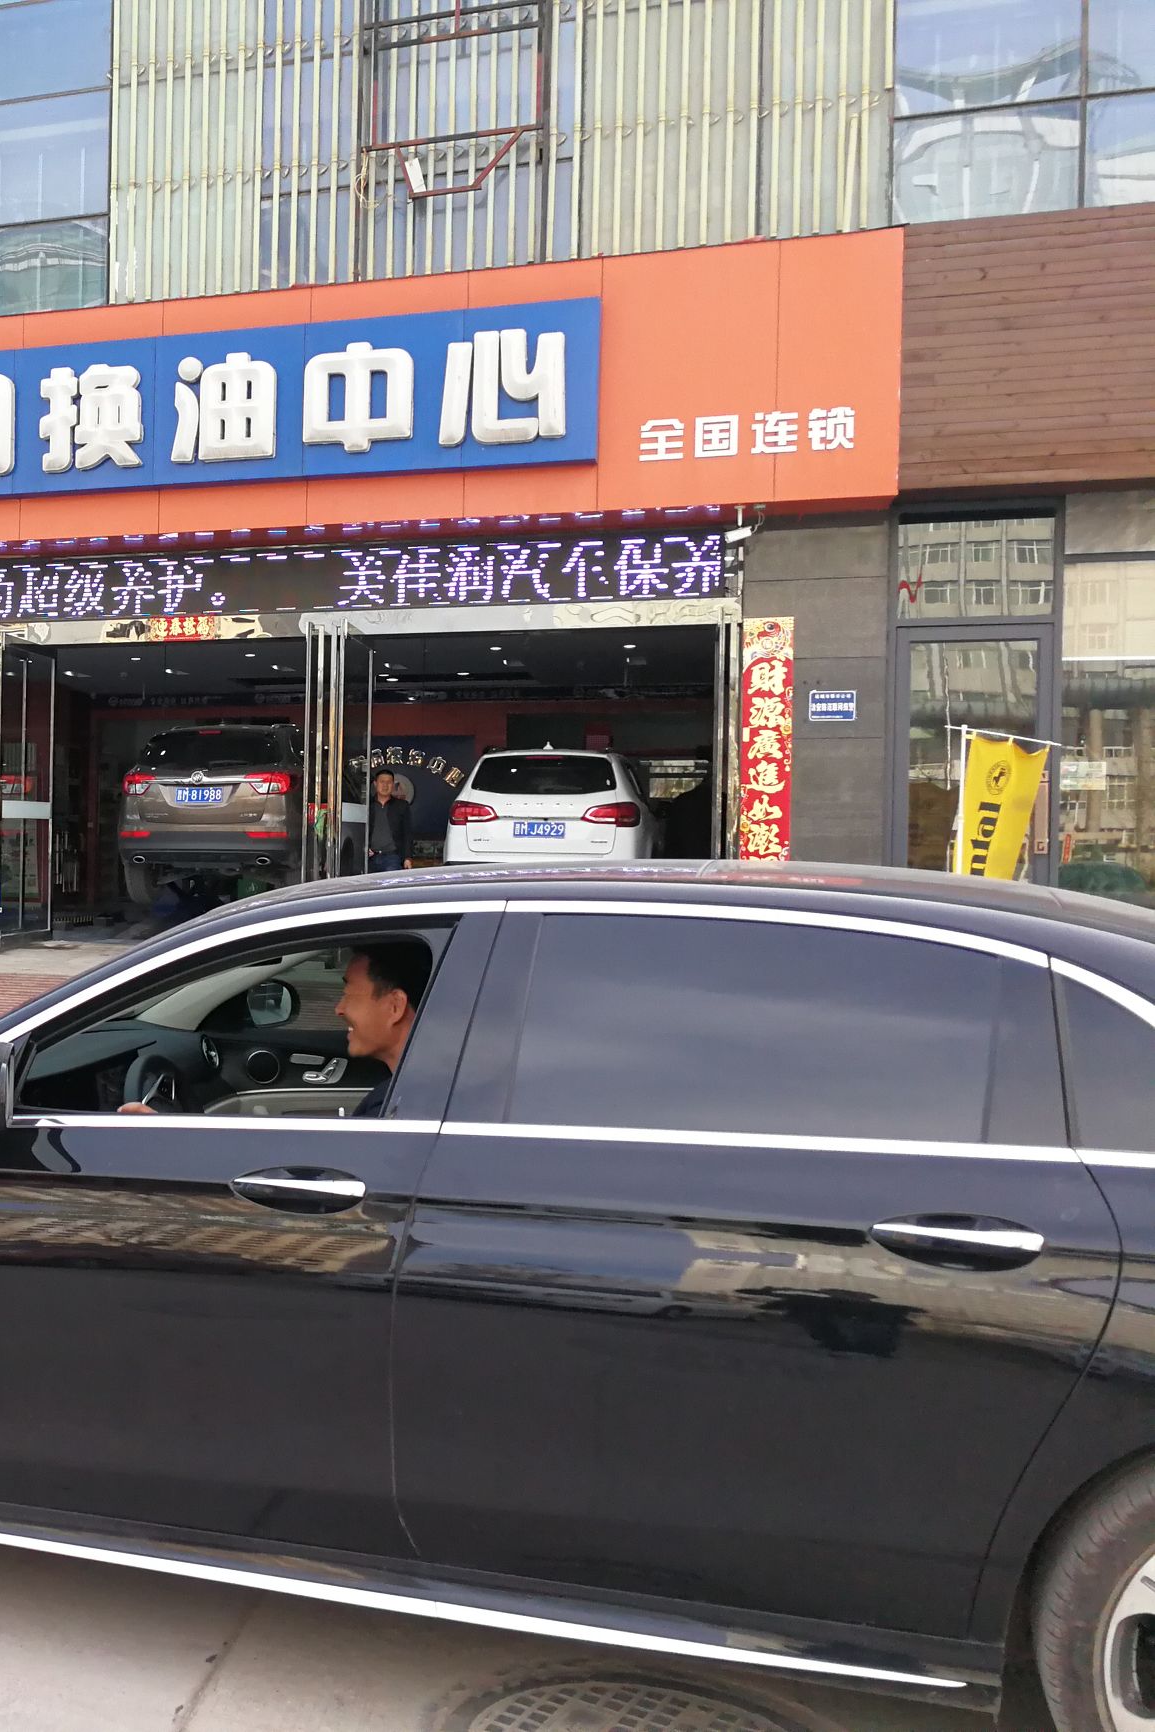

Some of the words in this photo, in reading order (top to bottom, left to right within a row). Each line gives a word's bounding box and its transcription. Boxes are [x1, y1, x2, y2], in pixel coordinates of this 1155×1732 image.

[639, 406, 856, 463] 全国连锁
[746, 659, 788, 861] 財源廣進如潮
